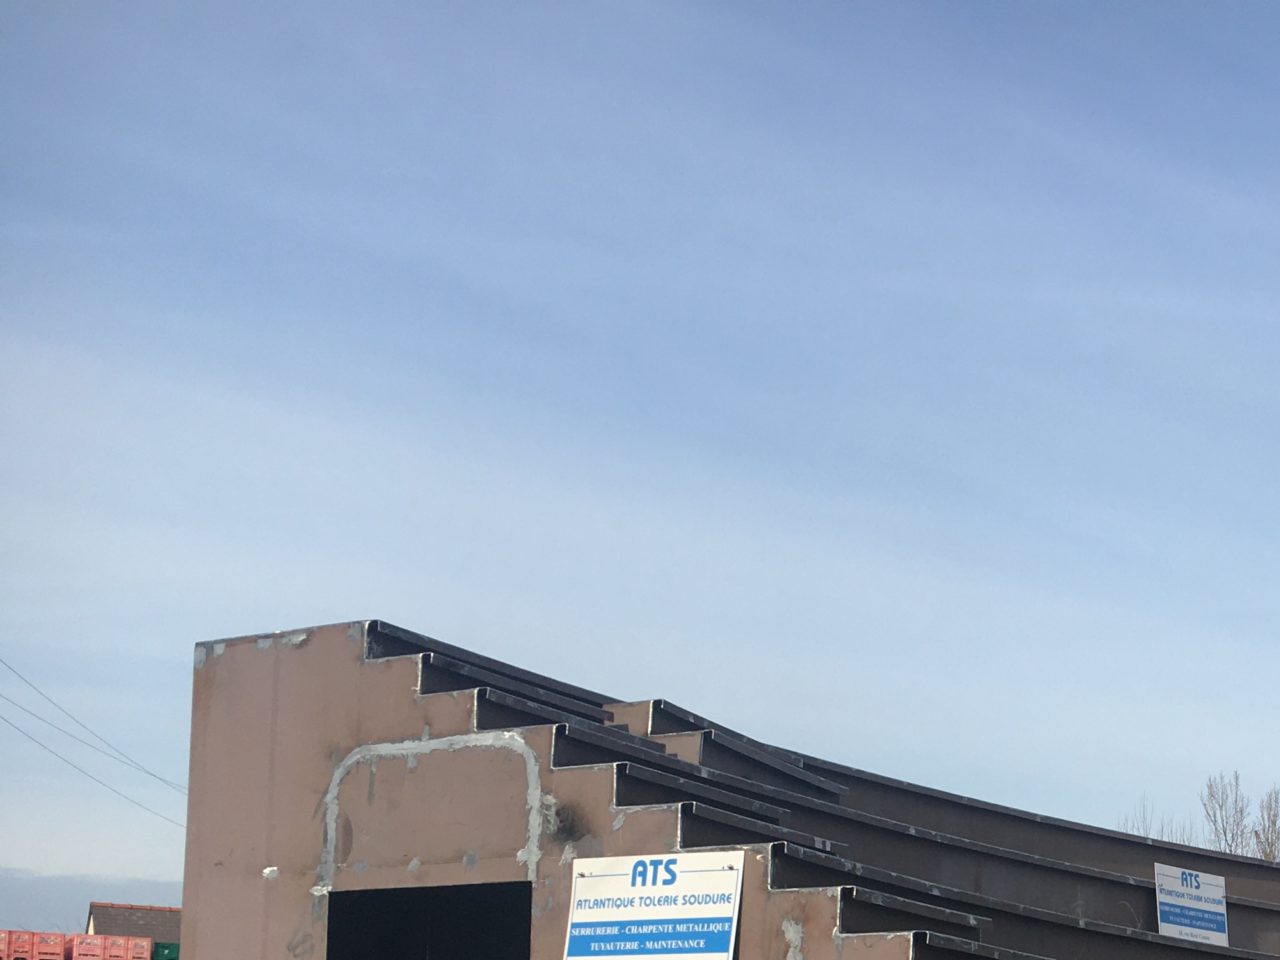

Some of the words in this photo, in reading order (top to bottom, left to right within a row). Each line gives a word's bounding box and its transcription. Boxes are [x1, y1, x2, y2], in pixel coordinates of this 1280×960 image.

[630, 858, 678, 887] ATS
[1181, 870, 1201, 890] ATS
[575, 897, 635, 911] ATLANTIQUE
[638, 895, 679, 908] TOLERIE
[681, 893, 733, 906] SOUDURE
[571, 926, 620, 936] SERRURERIE
[625, 924, 675, 935] CHARPENTE
[676, 922, 731, 933] METALLIQUE
[590, 941, 640, 951] TUYAUTERIE
[645, 939, 706, 950] MAINTENANCE
